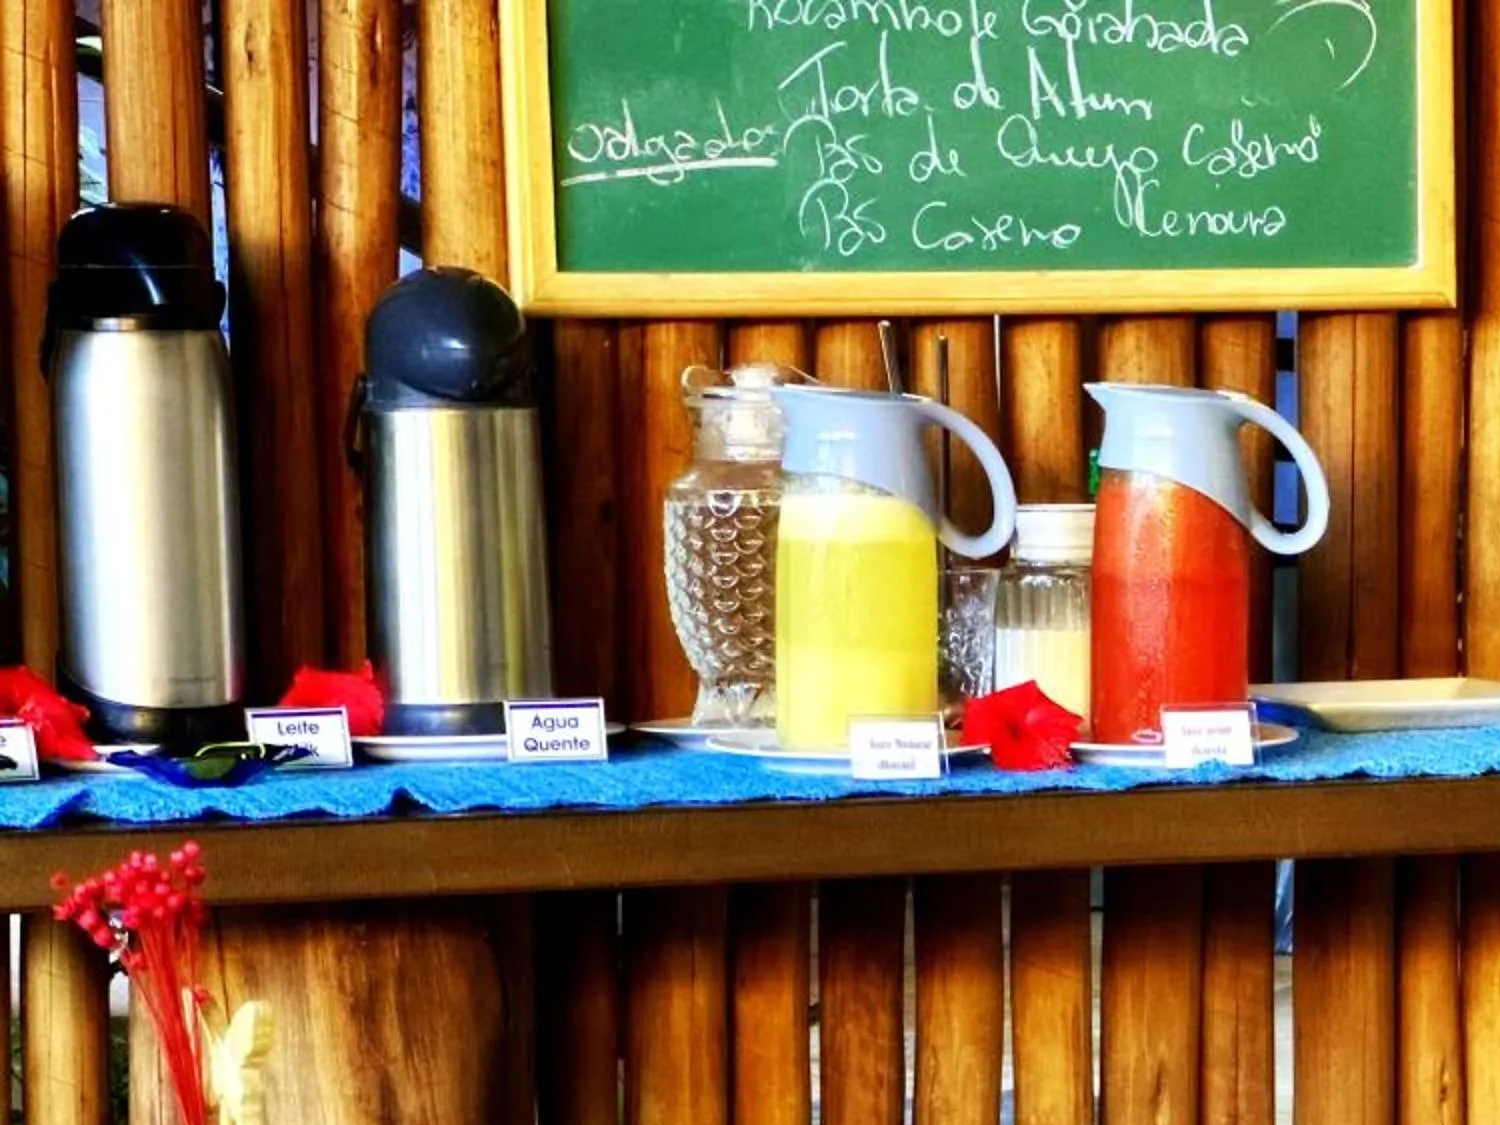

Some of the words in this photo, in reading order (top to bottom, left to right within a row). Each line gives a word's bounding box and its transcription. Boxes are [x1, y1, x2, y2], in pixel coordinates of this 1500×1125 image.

[908, 113, 968, 183] de
[277, 720, 320, 736] Leite
[523, 737, 591, 752] Quente
